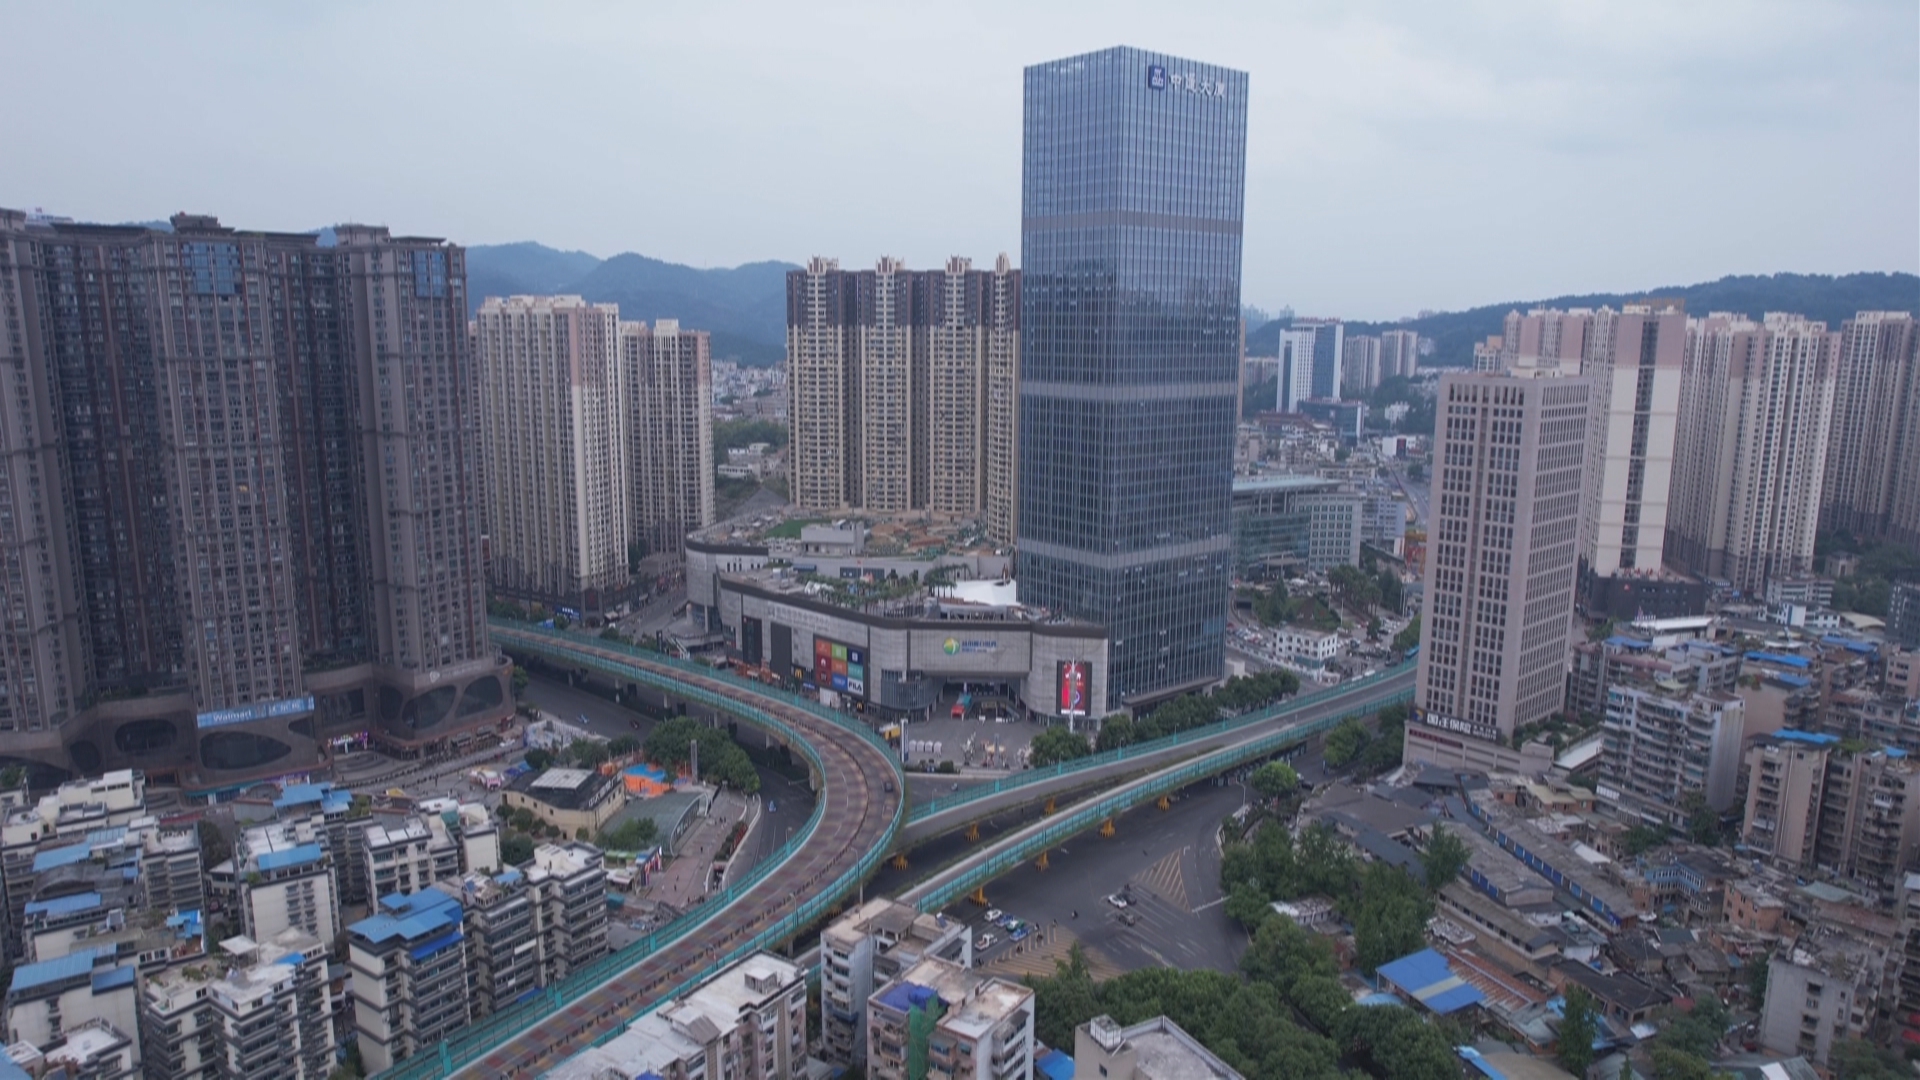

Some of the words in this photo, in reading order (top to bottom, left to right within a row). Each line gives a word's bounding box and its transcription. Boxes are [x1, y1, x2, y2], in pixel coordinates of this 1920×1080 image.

[848, 680, 862, 691] FILA
[213, 709, 251, 722] Walmart
[1427, 713, 1471, 734] 国任保险
